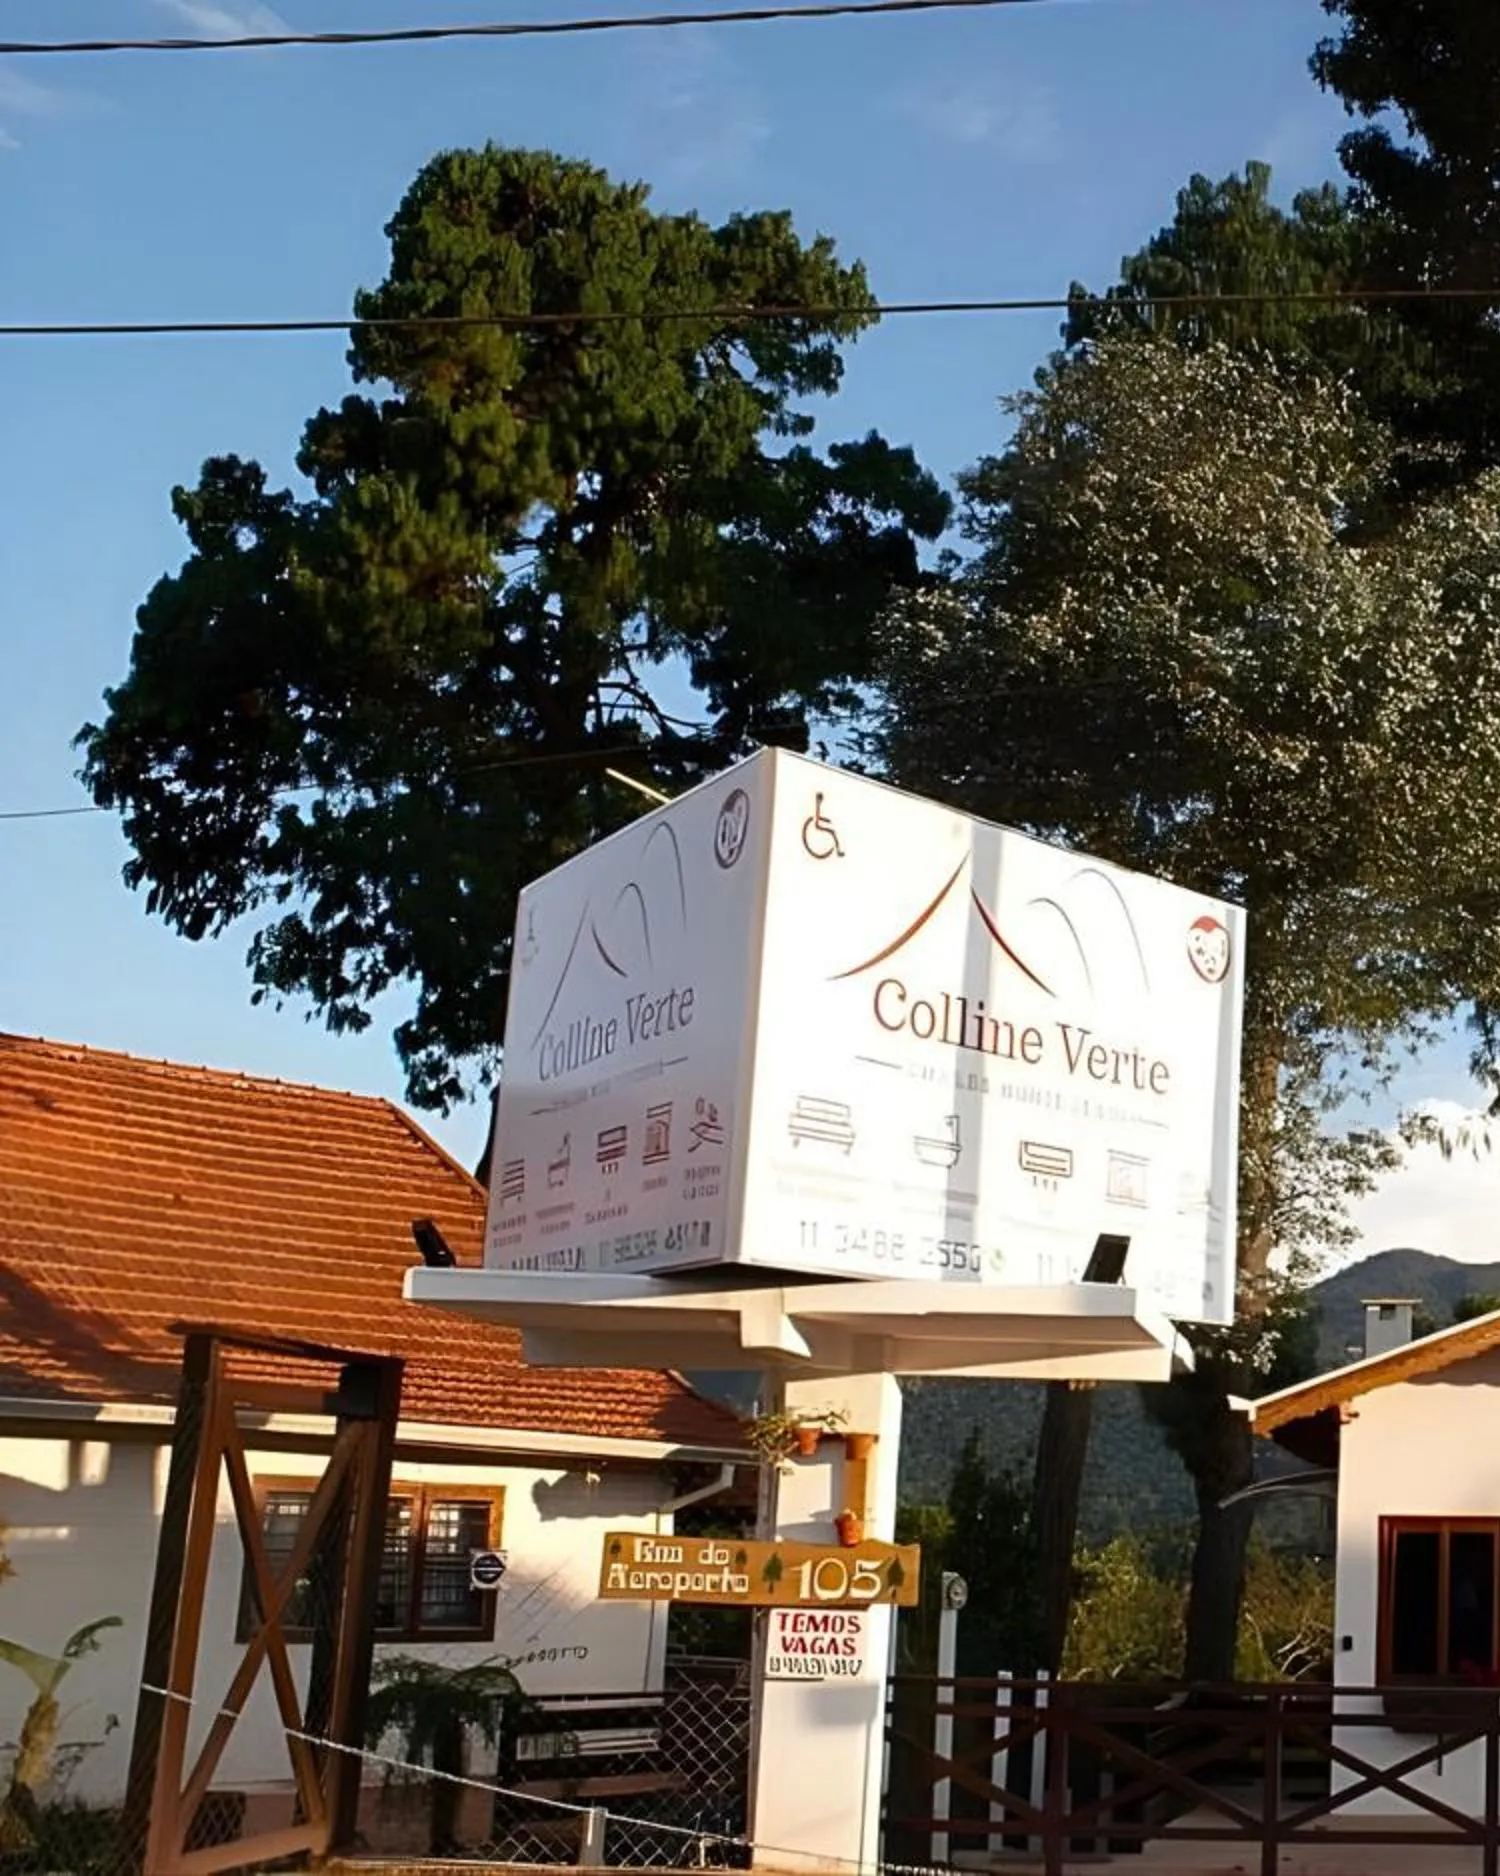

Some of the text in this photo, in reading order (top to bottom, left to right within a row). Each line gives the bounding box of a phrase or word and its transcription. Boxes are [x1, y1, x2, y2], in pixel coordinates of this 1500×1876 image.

[540, 987, 695, 1081] Colline Verte
[874, 978, 1042, 1064] Colline
[1056, 1022, 1169, 1094] Verte
[699, 1541, 729, 1564] do
[789, 1558, 882, 1600] 105
[776, 1612, 861, 1634] TEMOS
[782, 1636, 856, 1656] VAGAS
